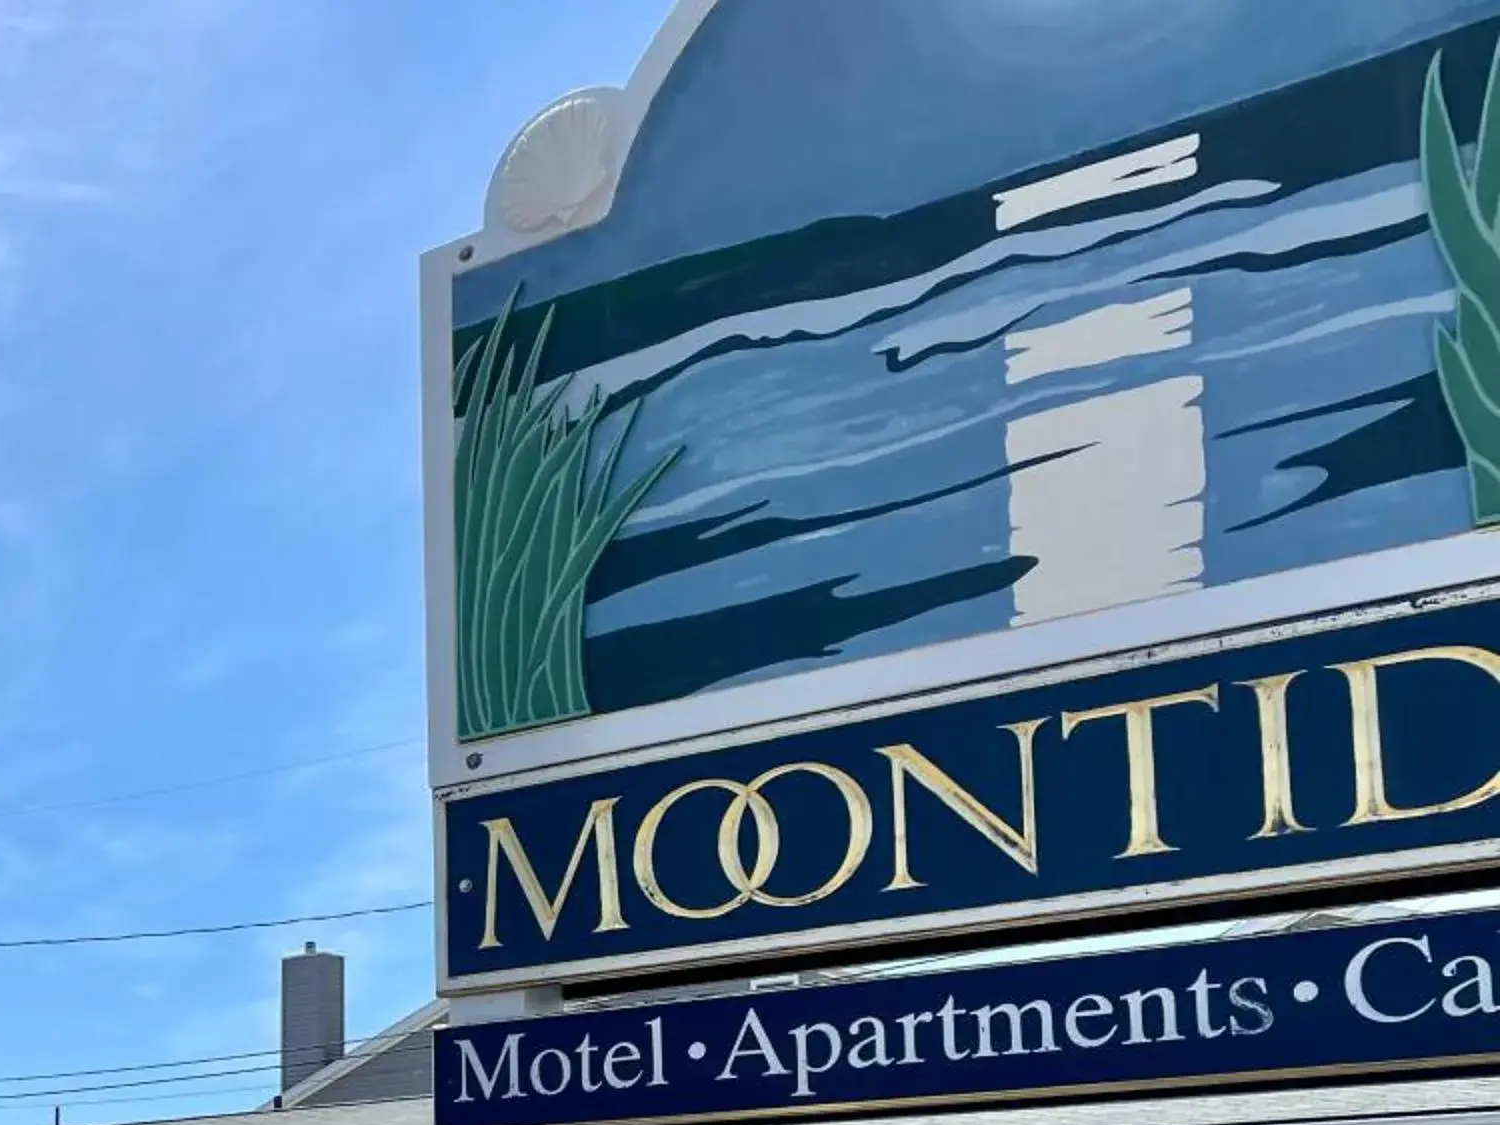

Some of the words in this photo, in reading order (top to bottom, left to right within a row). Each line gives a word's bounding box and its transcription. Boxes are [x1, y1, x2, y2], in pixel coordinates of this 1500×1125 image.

[453, 1016, 669, 1103] Motel
[714, 970, 1274, 1097] Apartments
[1343, 929, 1500, 1024] Ca
